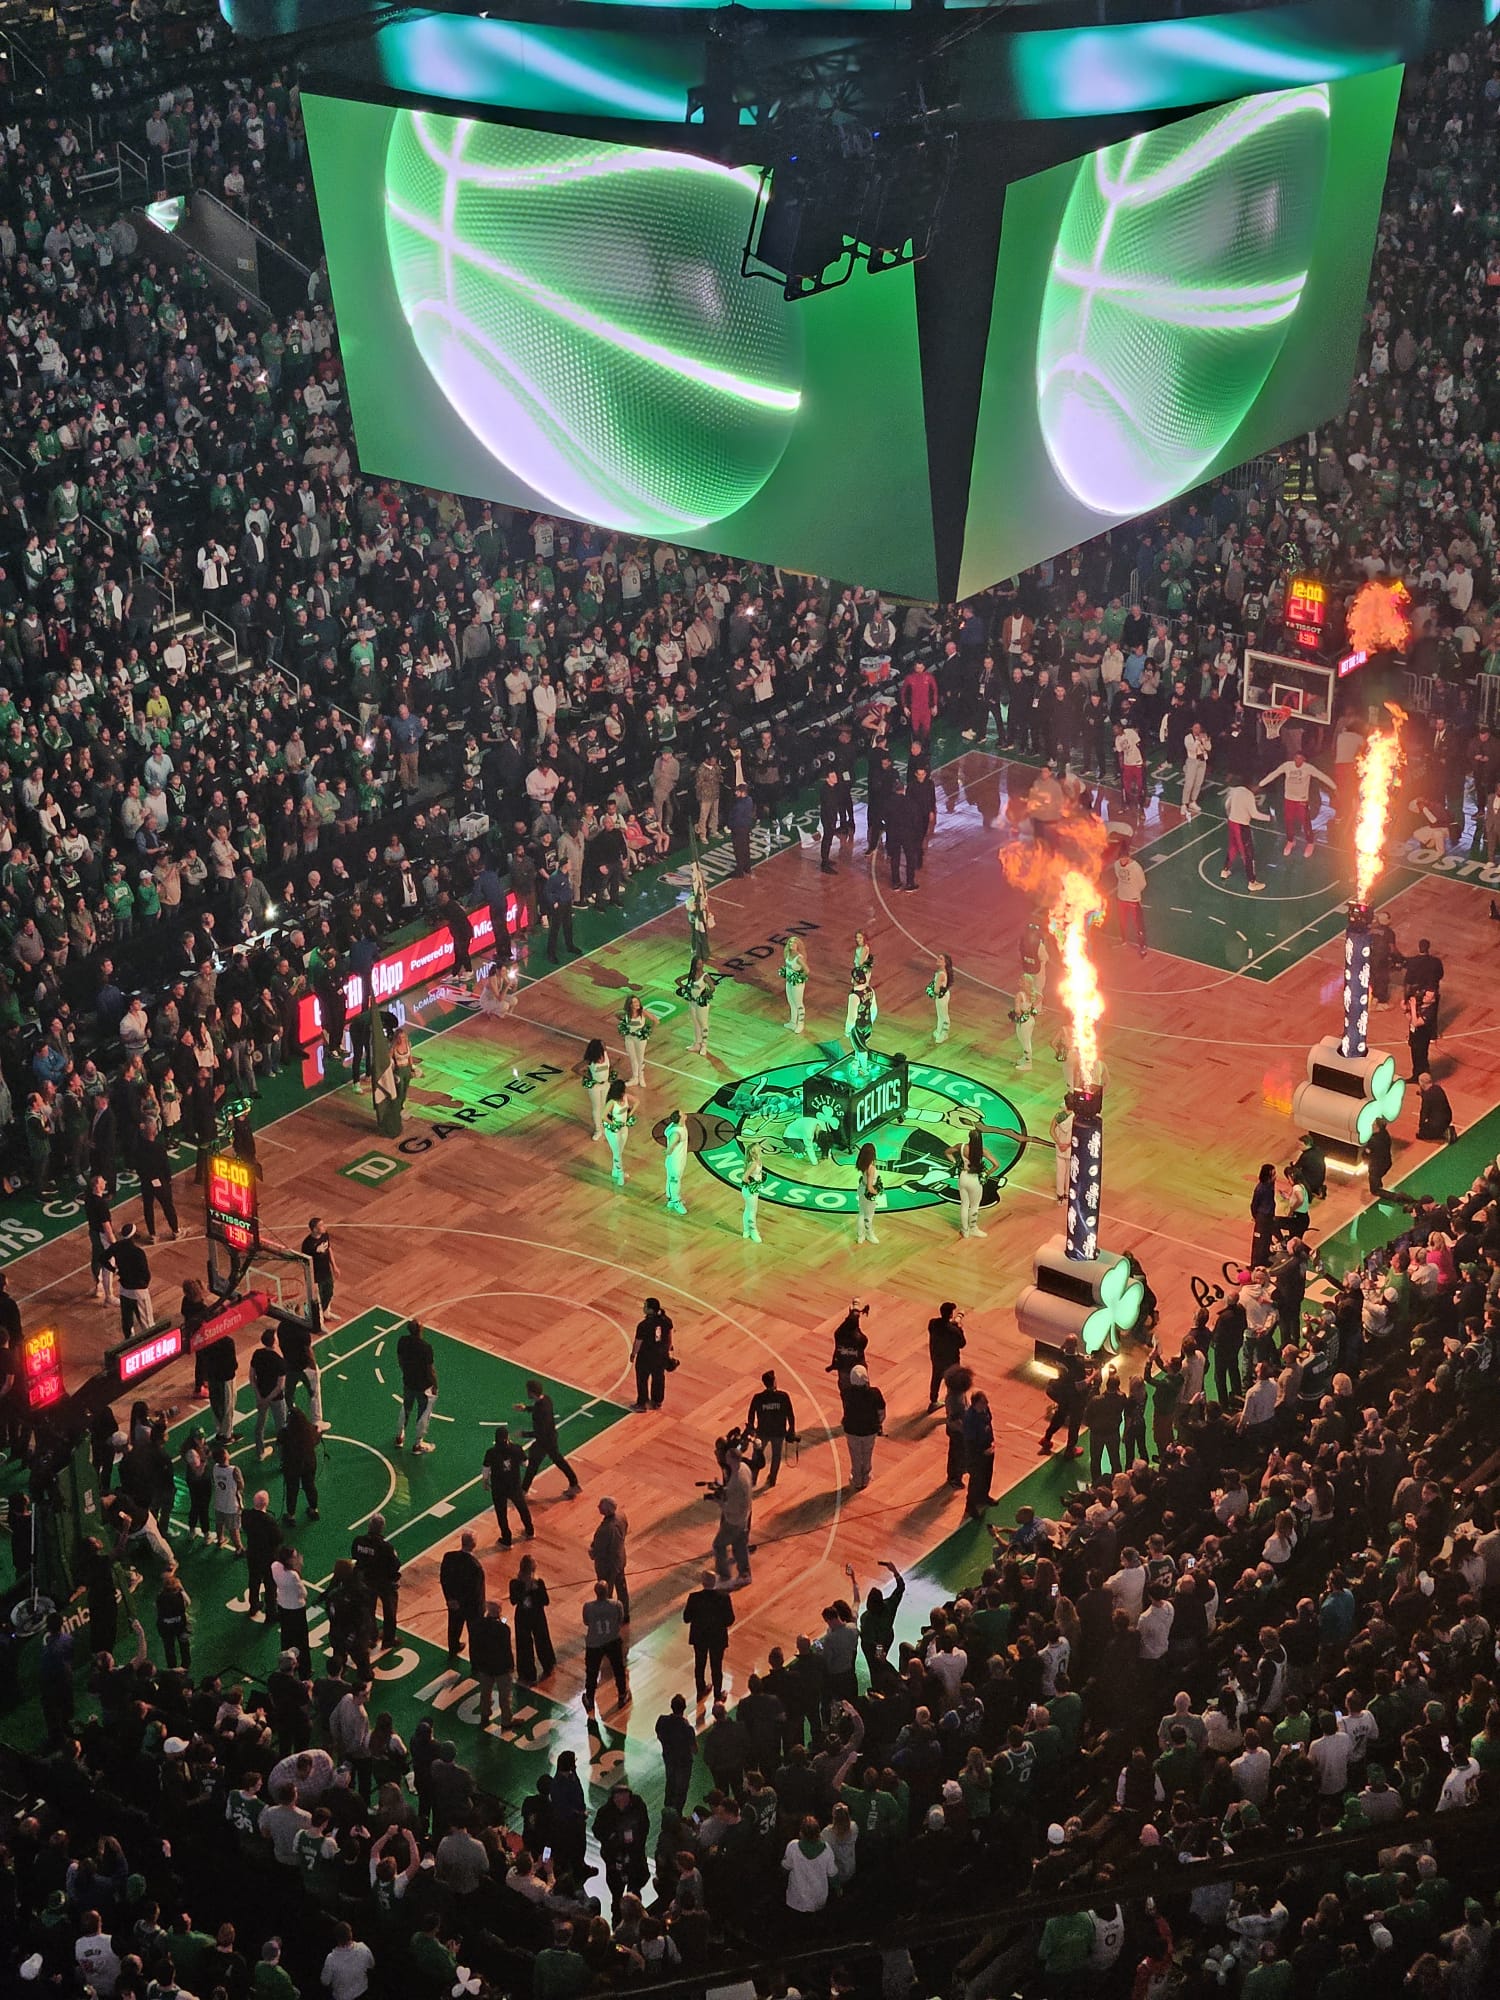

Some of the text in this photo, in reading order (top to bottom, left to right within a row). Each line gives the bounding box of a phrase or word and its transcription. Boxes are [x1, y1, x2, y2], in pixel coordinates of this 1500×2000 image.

[542, 536, 552, 545] 33
[1293, 581, 1323, 602] 12:00
[1289, 596, 1320, 623] 24
[1296, 623, 1322, 634] TISSOT
[380, 960, 403, 995] App
[410, 947, 443, 971] Powered
[444, 942, 454, 958] by
[811, 1094, 845, 1117] CELTICS
[857, 1078, 901, 1132] CELTICS
[345, 1064, 565, 1179] TD GARDEN
[213, 1158, 249, 1188] 12:00
[213, 1175, 249, 1216] 24
[221, 1213, 251, 1231] TISSOT
[228, 1226, 248, 1245] 1:30
[29, 1330, 54, 1355] 12:00
[32, 1347, 51, 1372] 24
[125, 1337, 176, 1374] GET THE App
